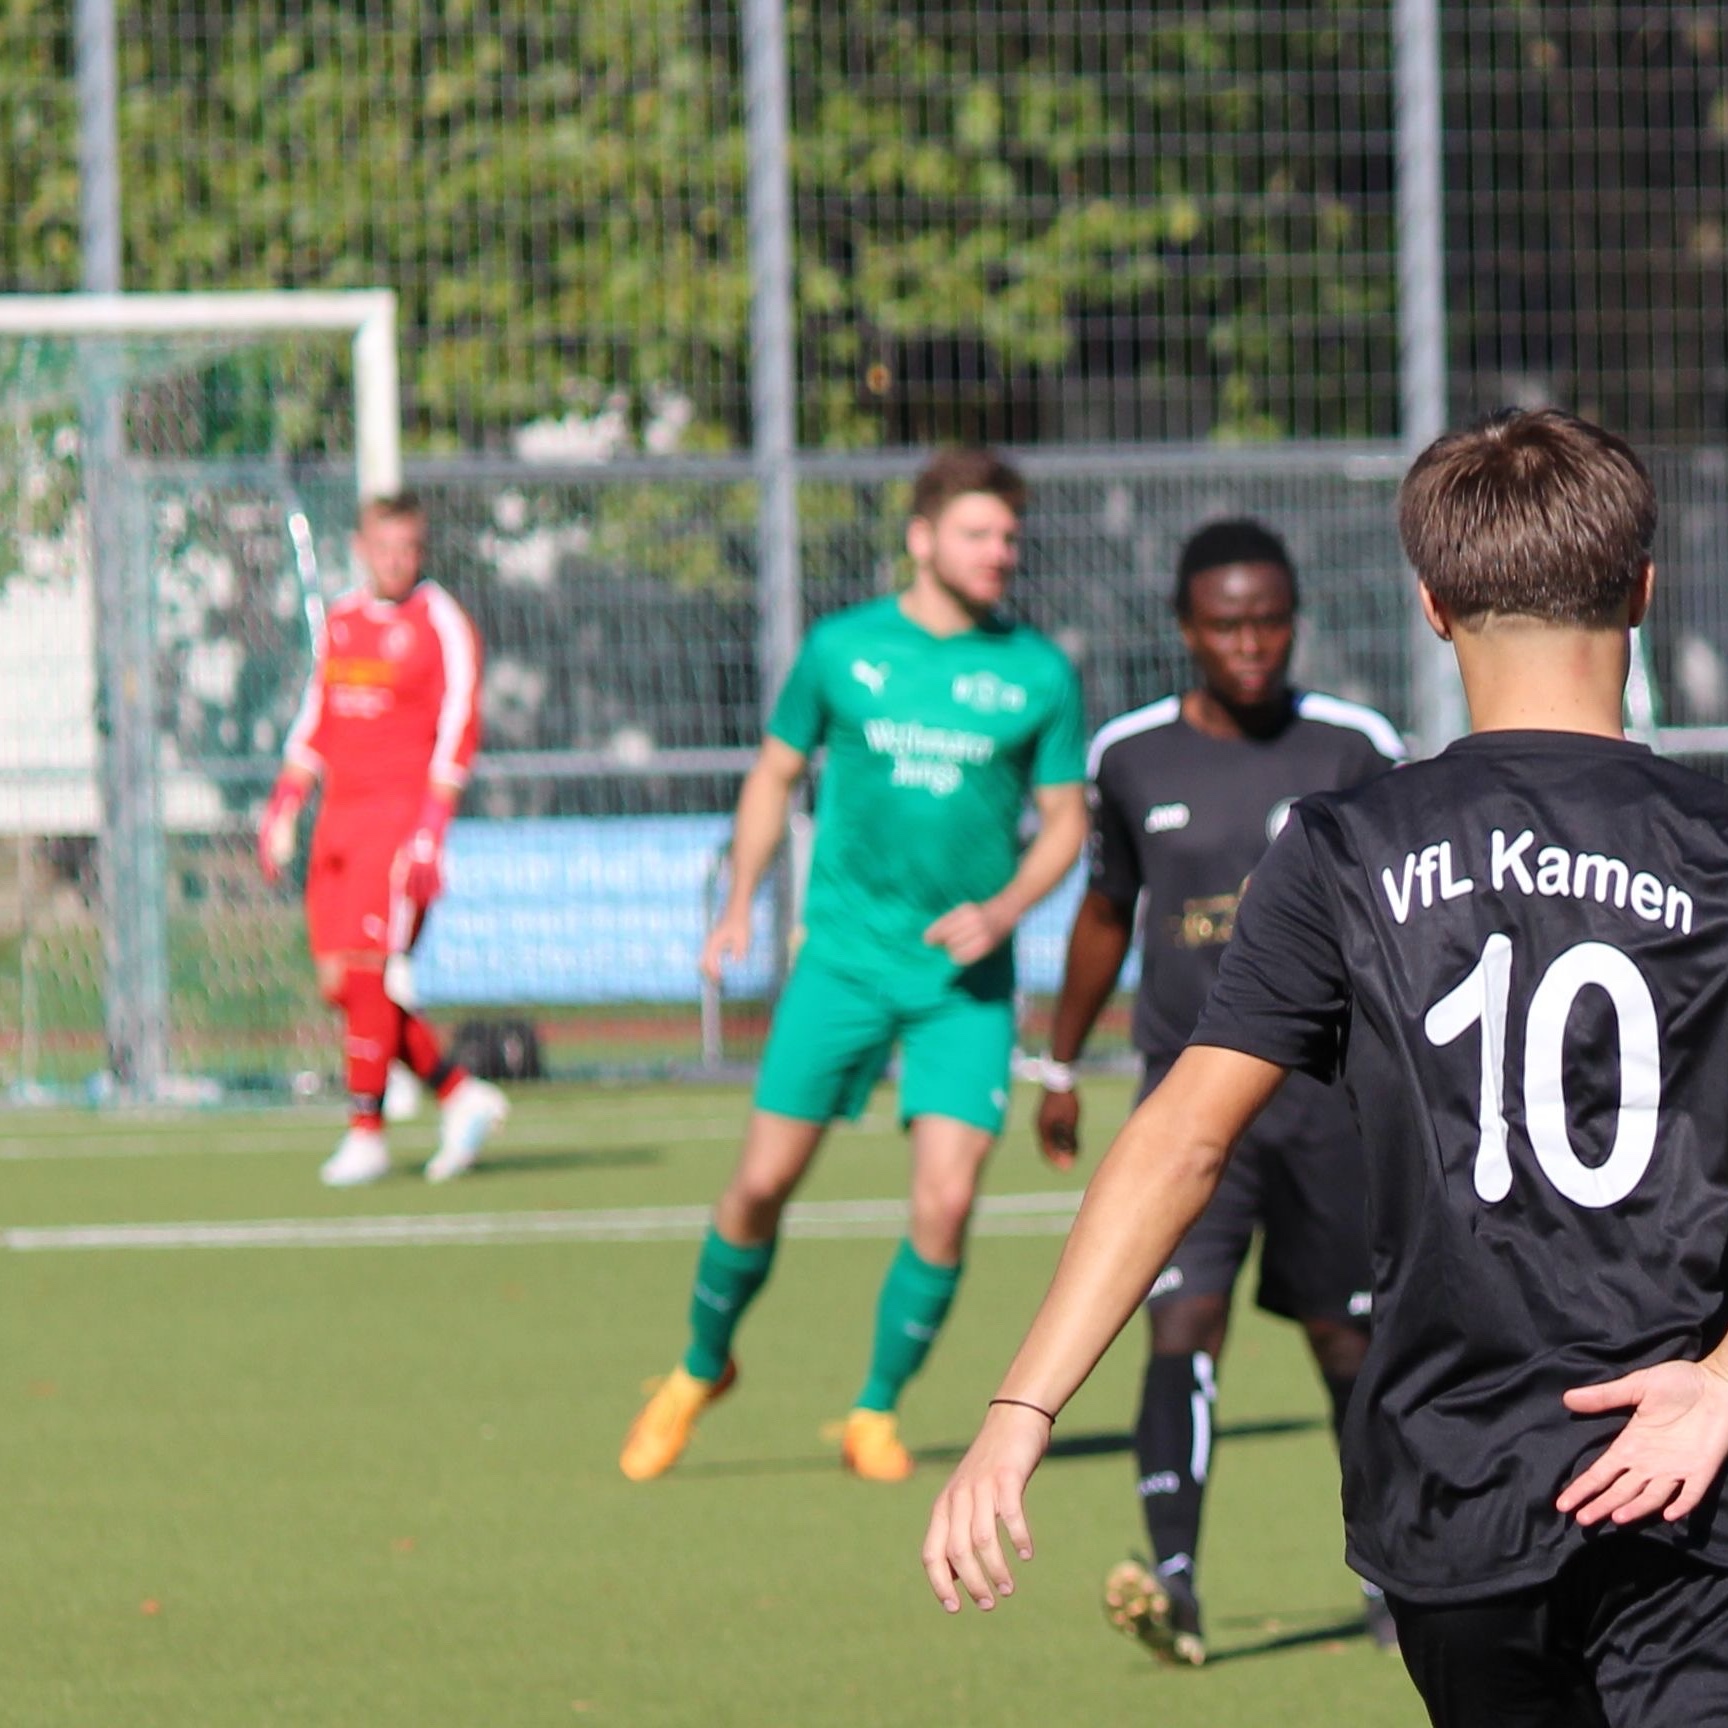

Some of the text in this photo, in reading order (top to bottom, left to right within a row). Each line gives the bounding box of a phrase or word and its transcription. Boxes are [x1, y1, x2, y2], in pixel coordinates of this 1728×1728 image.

[1382, 830, 1692, 934] VfL Kamen
[1425, 933, 1660, 1208] 10
